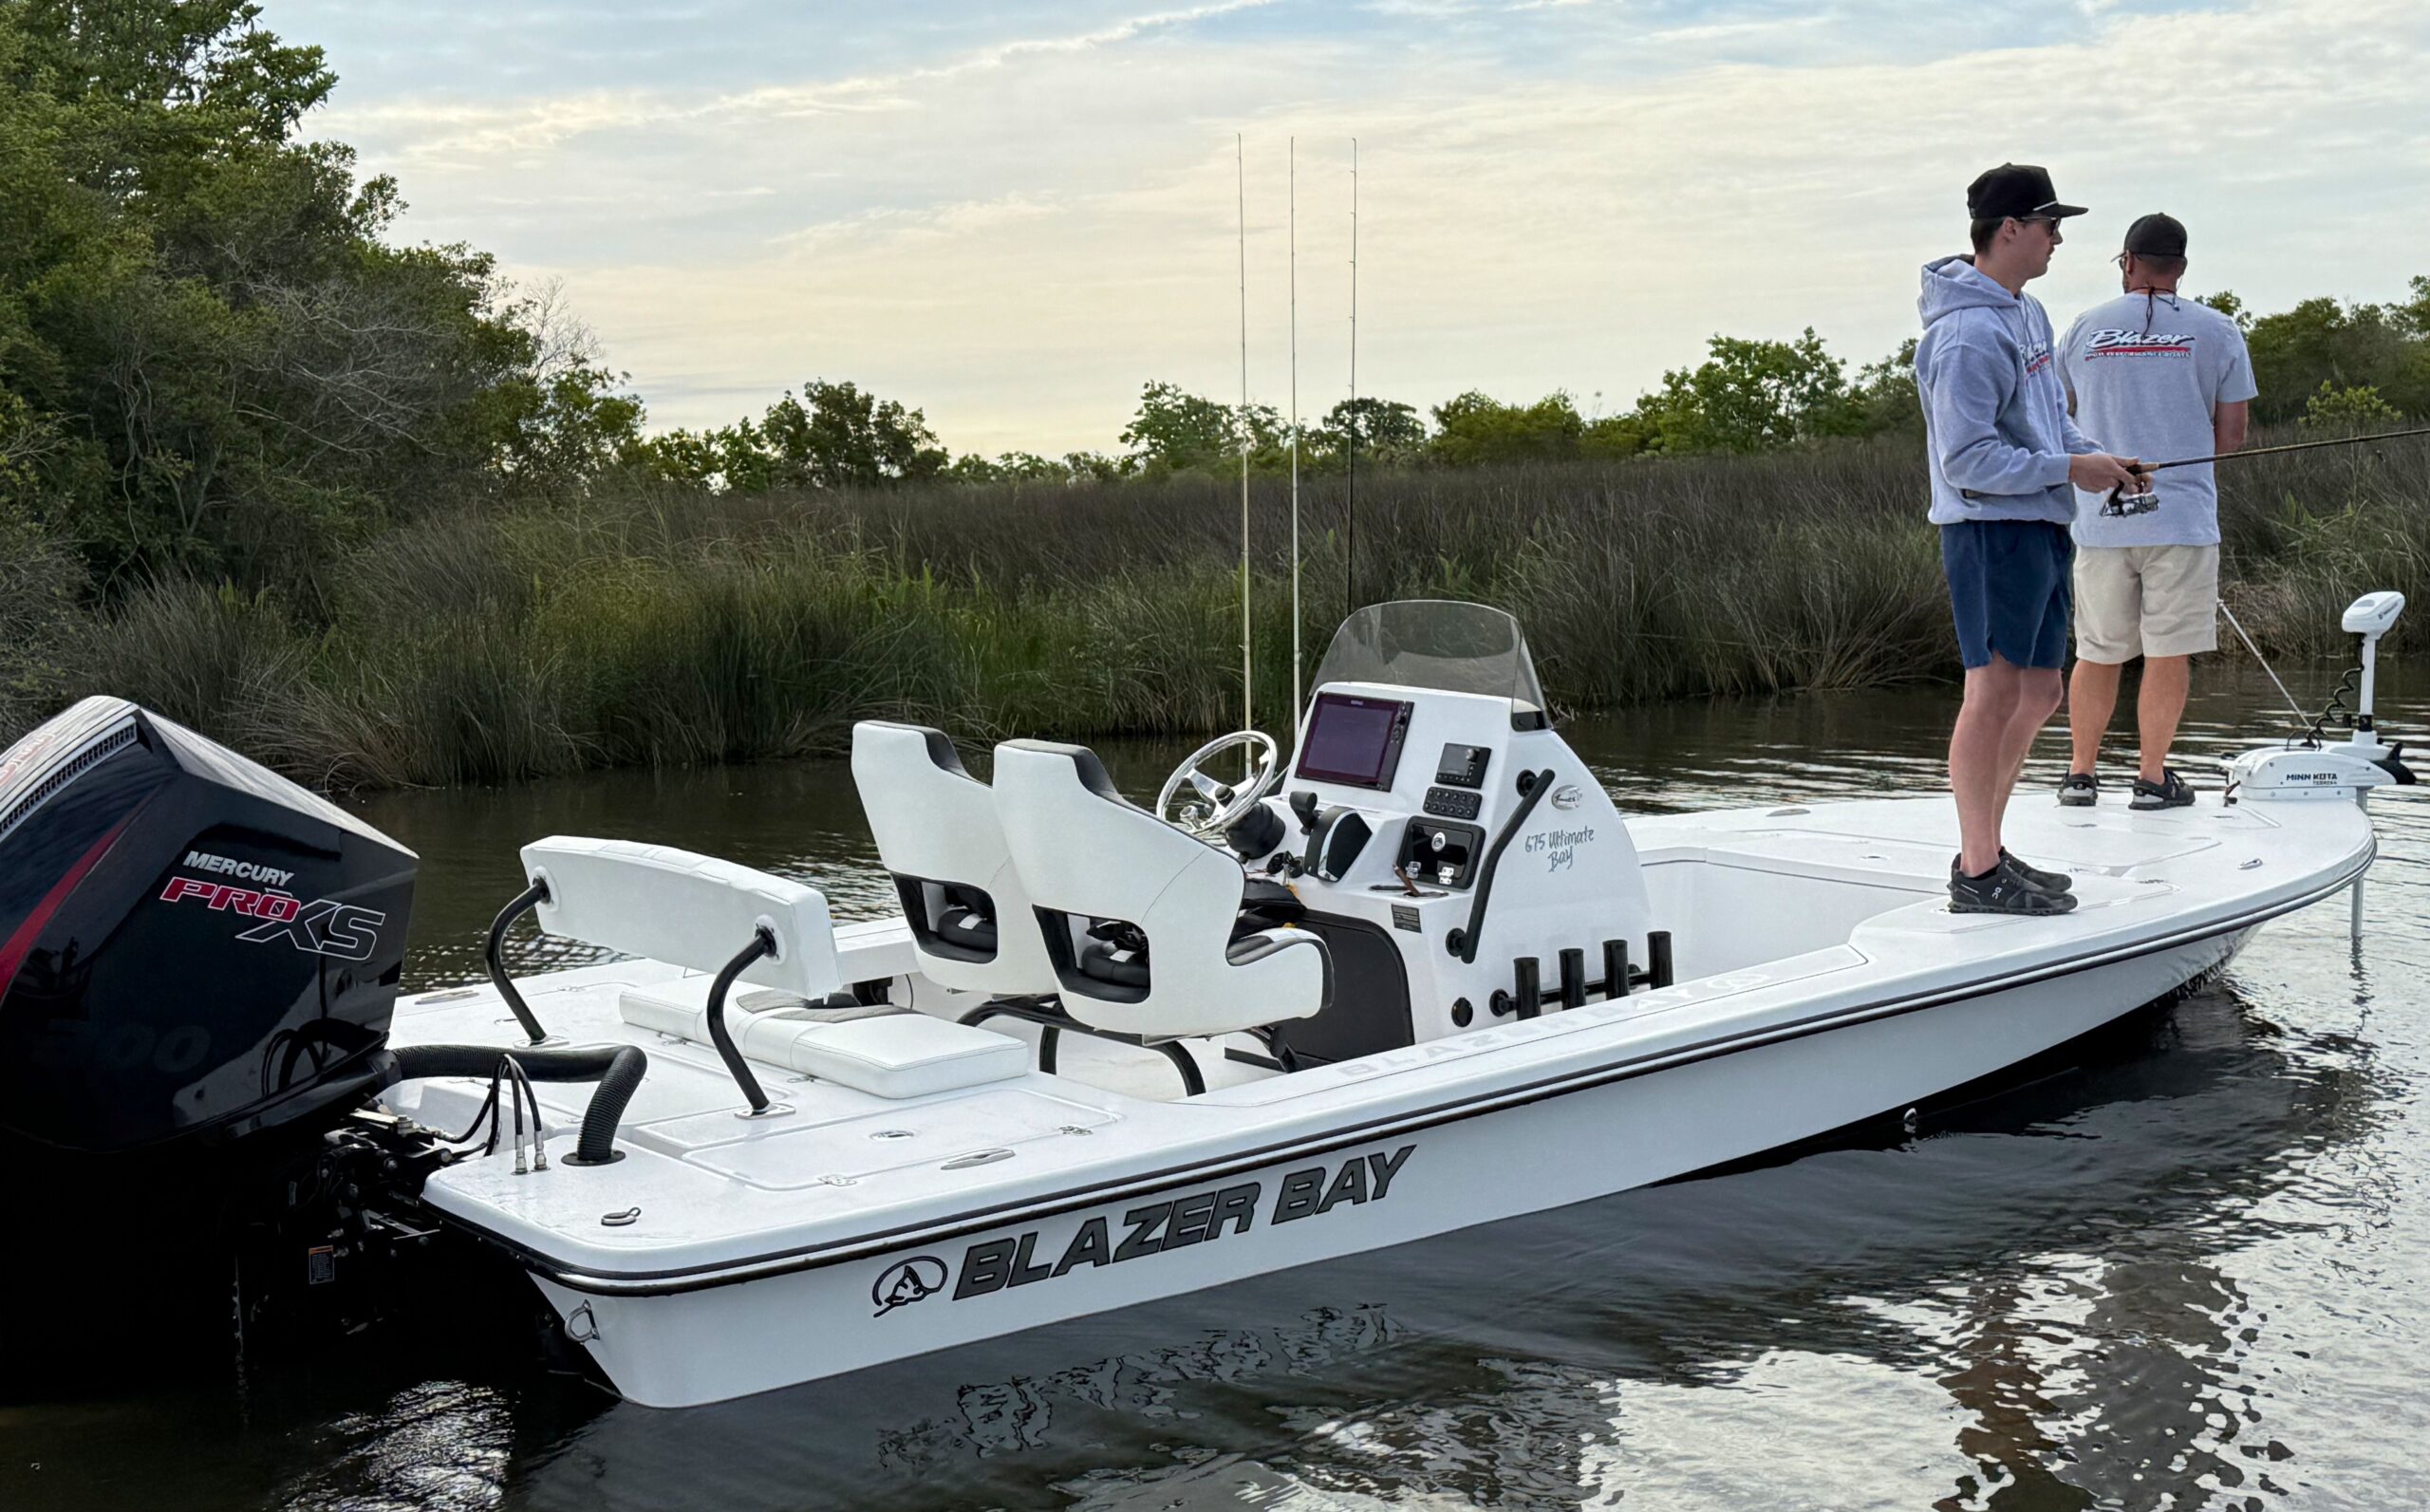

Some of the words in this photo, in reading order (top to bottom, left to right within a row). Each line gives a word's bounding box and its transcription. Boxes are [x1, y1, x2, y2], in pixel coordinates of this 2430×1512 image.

[2086, 328, 2196, 348] Blazer
[1524, 832, 1547, 853] 675
[1548, 825, 1595, 849] Ultimate
[182, 849, 295, 887] MERCURY
[1547, 845, 1574, 873] Bay
[159, 875, 302, 923] PRO
[234, 898, 386, 961] XS
[952, 1181, 1262, 1301] BLAZER
[1271, 1144, 1418, 1225] BAY
